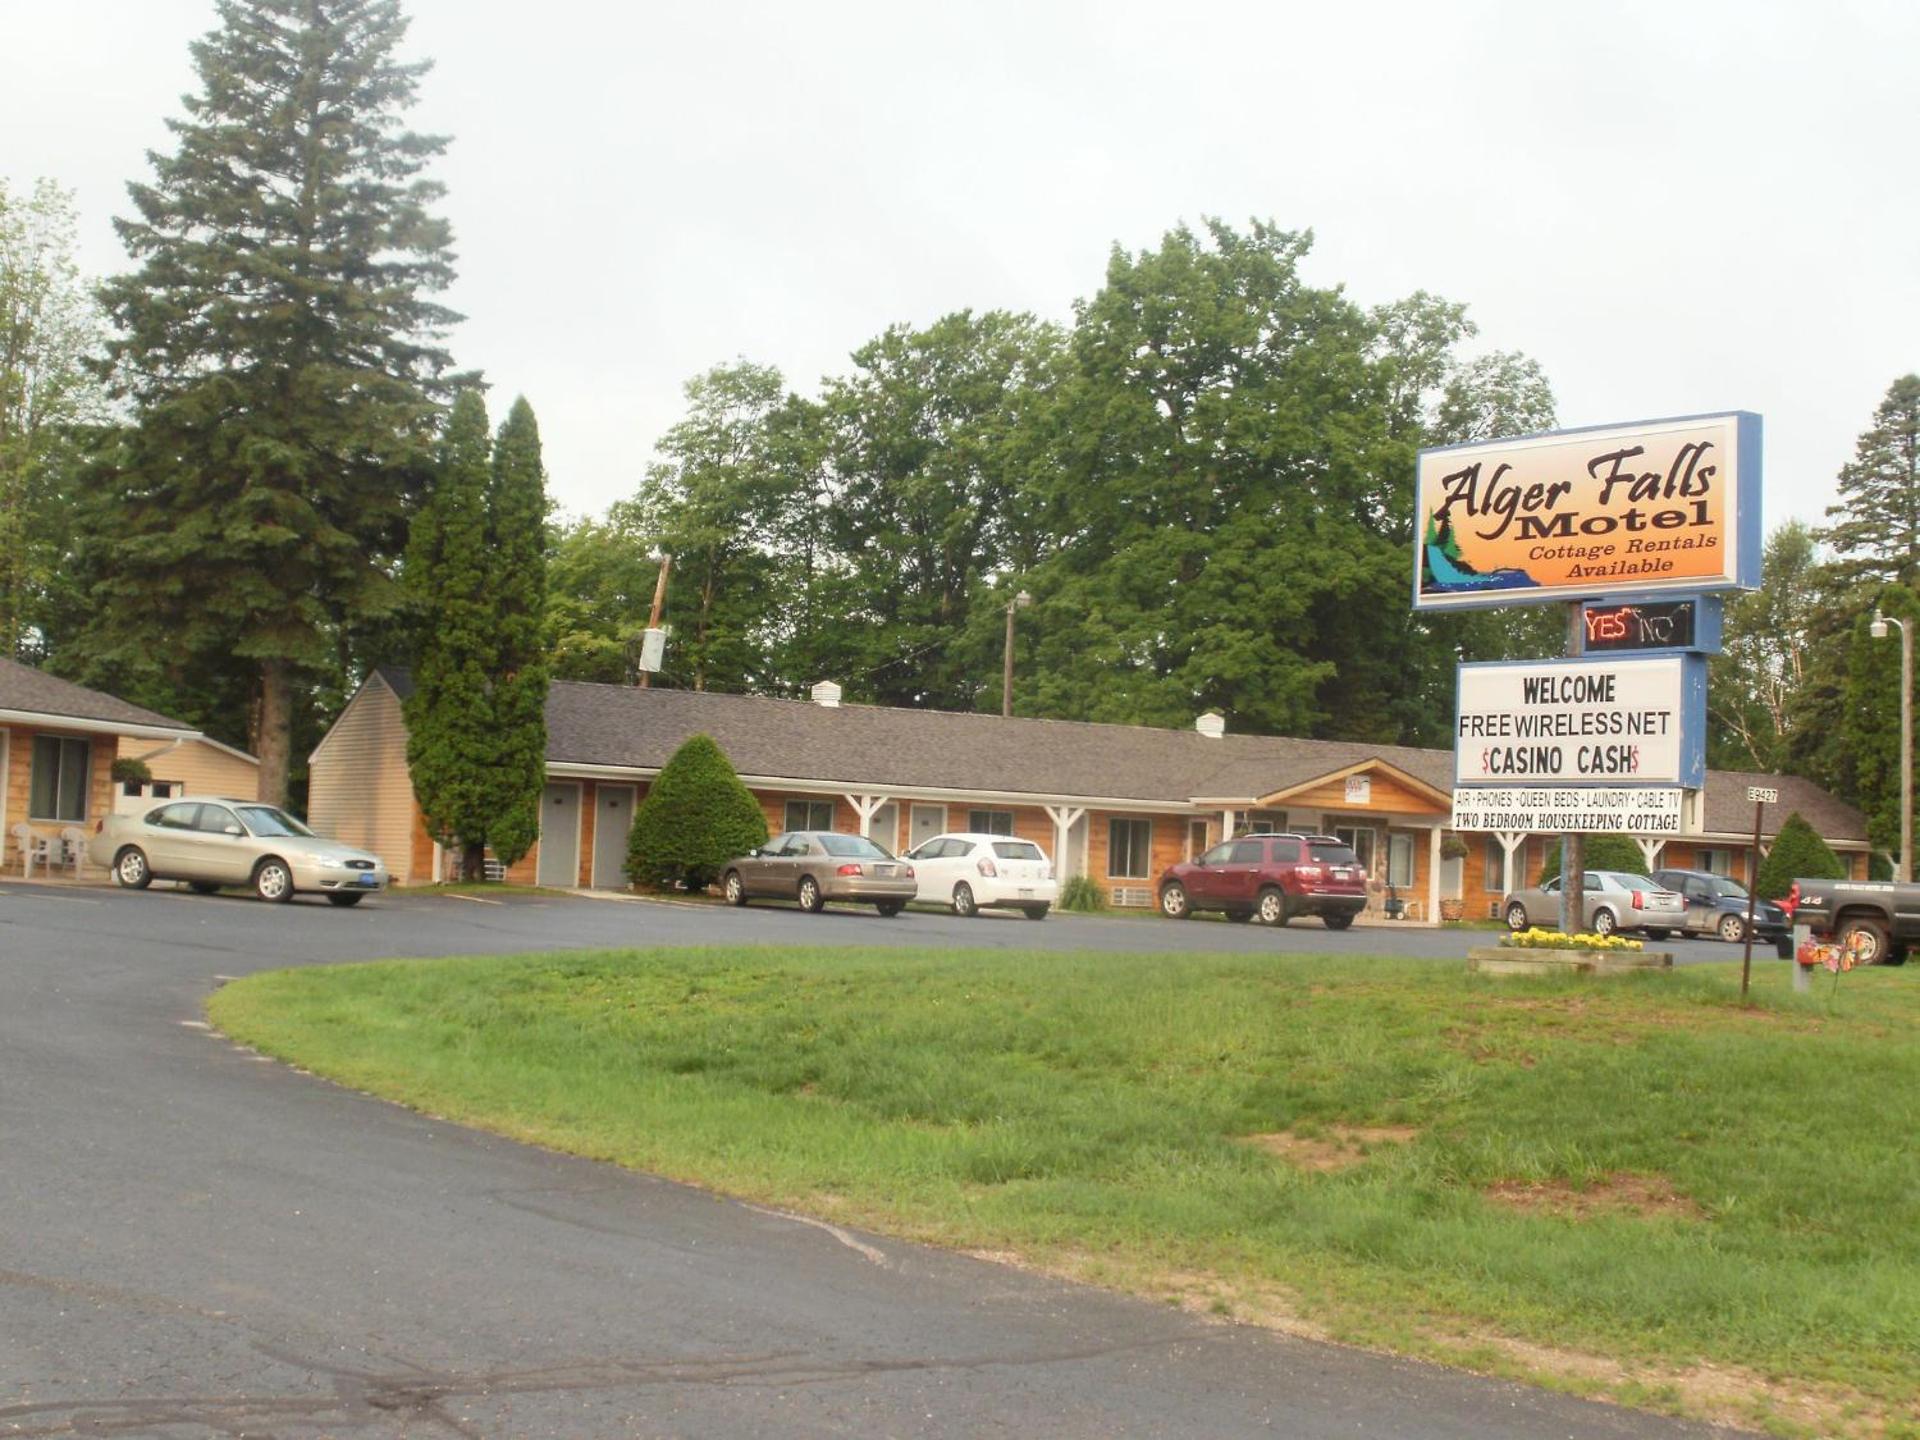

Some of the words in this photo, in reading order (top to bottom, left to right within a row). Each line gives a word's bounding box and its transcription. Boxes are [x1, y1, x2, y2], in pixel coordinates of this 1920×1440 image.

[1434, 462, 1572, 541] Alger
[1587, 441, 1716, 506] Falls
[1514, 500, 1714, 541] Motel
[1529, 543, 1616, 561] Cottage
[1625, 533, 1718, 554] Rentals
[1566, 558, 1674, 579] Available
[1584, 608, 1628, 641] YES
[1637, 612, 1674, 642] NO
[1523, 674, 1616, 704] WELCOME
[1459, 713, 1511, 737] FREE
[1515, 711, 1623, 737] WIRELESS
[1627, 711, 1671, 736] NET
[1456, 791, 1471, 806] AIR
[1477, 791, 1513, 807] PHONES
[1519, 791, 1551, 807] QUEEN
[1554, 791, 1580, 807] BEDS
[1586, 791, 1631, 808] LAUNDRY
[1637, 791, 1665, 808] CABLE
[1668, 791, 1681, 808] TV
[1456, 812, 1480, 828] TWO
[1483, 812, 1535, 829] BEDROOM
[1538, 813, 1623, 830] HOUSEKEEPING
[1627, 813, 1679, 831] COTTAGE
